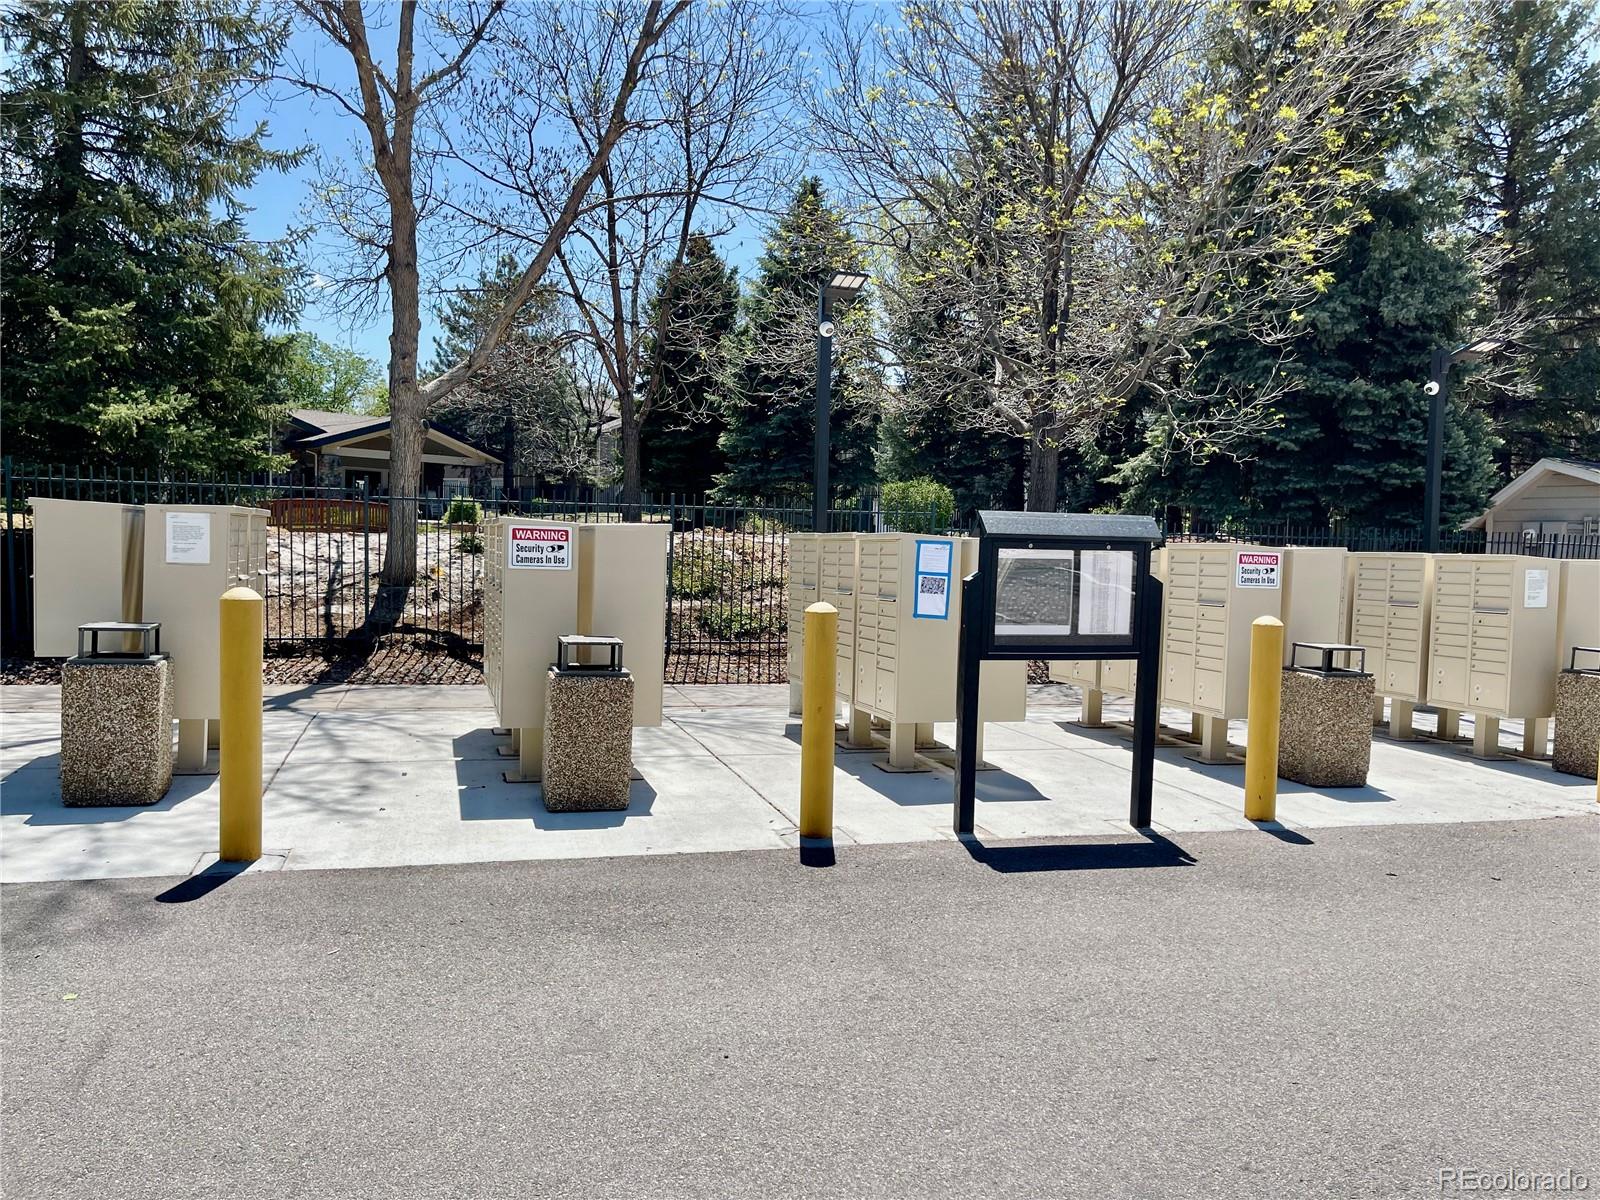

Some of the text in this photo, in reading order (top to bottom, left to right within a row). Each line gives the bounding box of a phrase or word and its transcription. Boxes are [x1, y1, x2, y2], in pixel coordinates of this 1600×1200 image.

[515, 530, 566, 540] WARNING
[515, 543, 544, 554] Security
[515, 554, 565, 564] Cameras In Use
[1241, 555, 1277, 564] WARNING
[1241, 566, 1261, 576] Security
[1240, 575, 1260, 584] Cameras
[1267, 576, 1275, 584] Use
